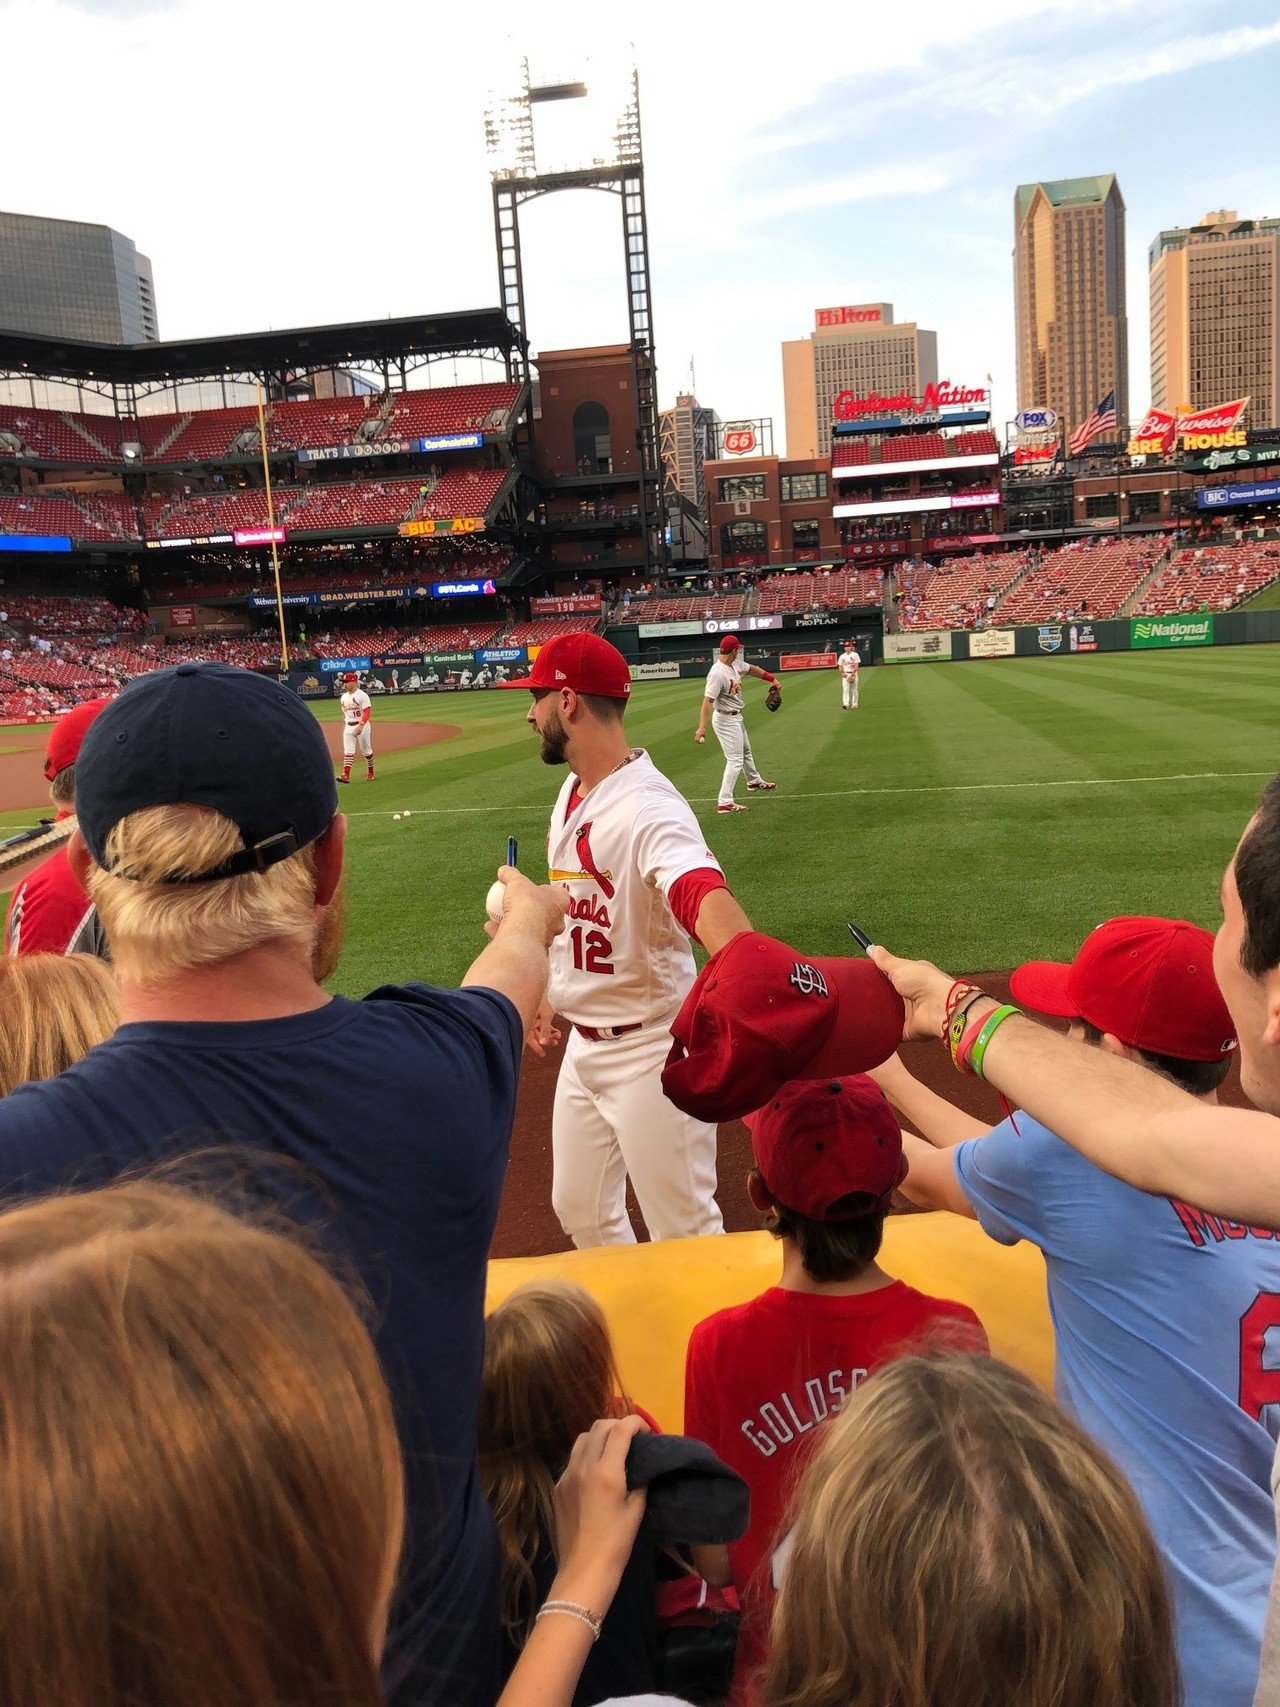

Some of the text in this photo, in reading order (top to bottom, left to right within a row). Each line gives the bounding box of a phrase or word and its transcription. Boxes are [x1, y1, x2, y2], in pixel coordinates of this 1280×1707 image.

[817, 306, 880, 326] Hilton
[914, 381, 986, 414] Nation
[901, 414, 943, 426] ROOFTOP
[1023, 411, 1047, 424] FOX
[727, 424, 752, 432] PHILLIPS
[727, 434, 751, 449] 66
[1127, 430, 1248, 455] BRE HOUSE
[307, 448, 338, 460] THAT'S
[343, 447, 350, 458] A
[1257, 450, 1277, 461] MVP
[1207, 492, 1226, 502] BJC
[1230, 490, 1254, 500] Choose
[1256, 488, 1276, 497] Better
[407, 520, 435, 535] BIG
[320, 588, 403, 600] GRAD.WEBSTER.EDU
[253, 597, 278, 605] Webster
[1150, 621, 1208, 636] National
[433, 652, 474, 662] Central Bank
[482, 649, 520, 658] ATHLETICO
[640, 667, 678, 675] Ameritrade
[570, 925, 615, 975] 12
